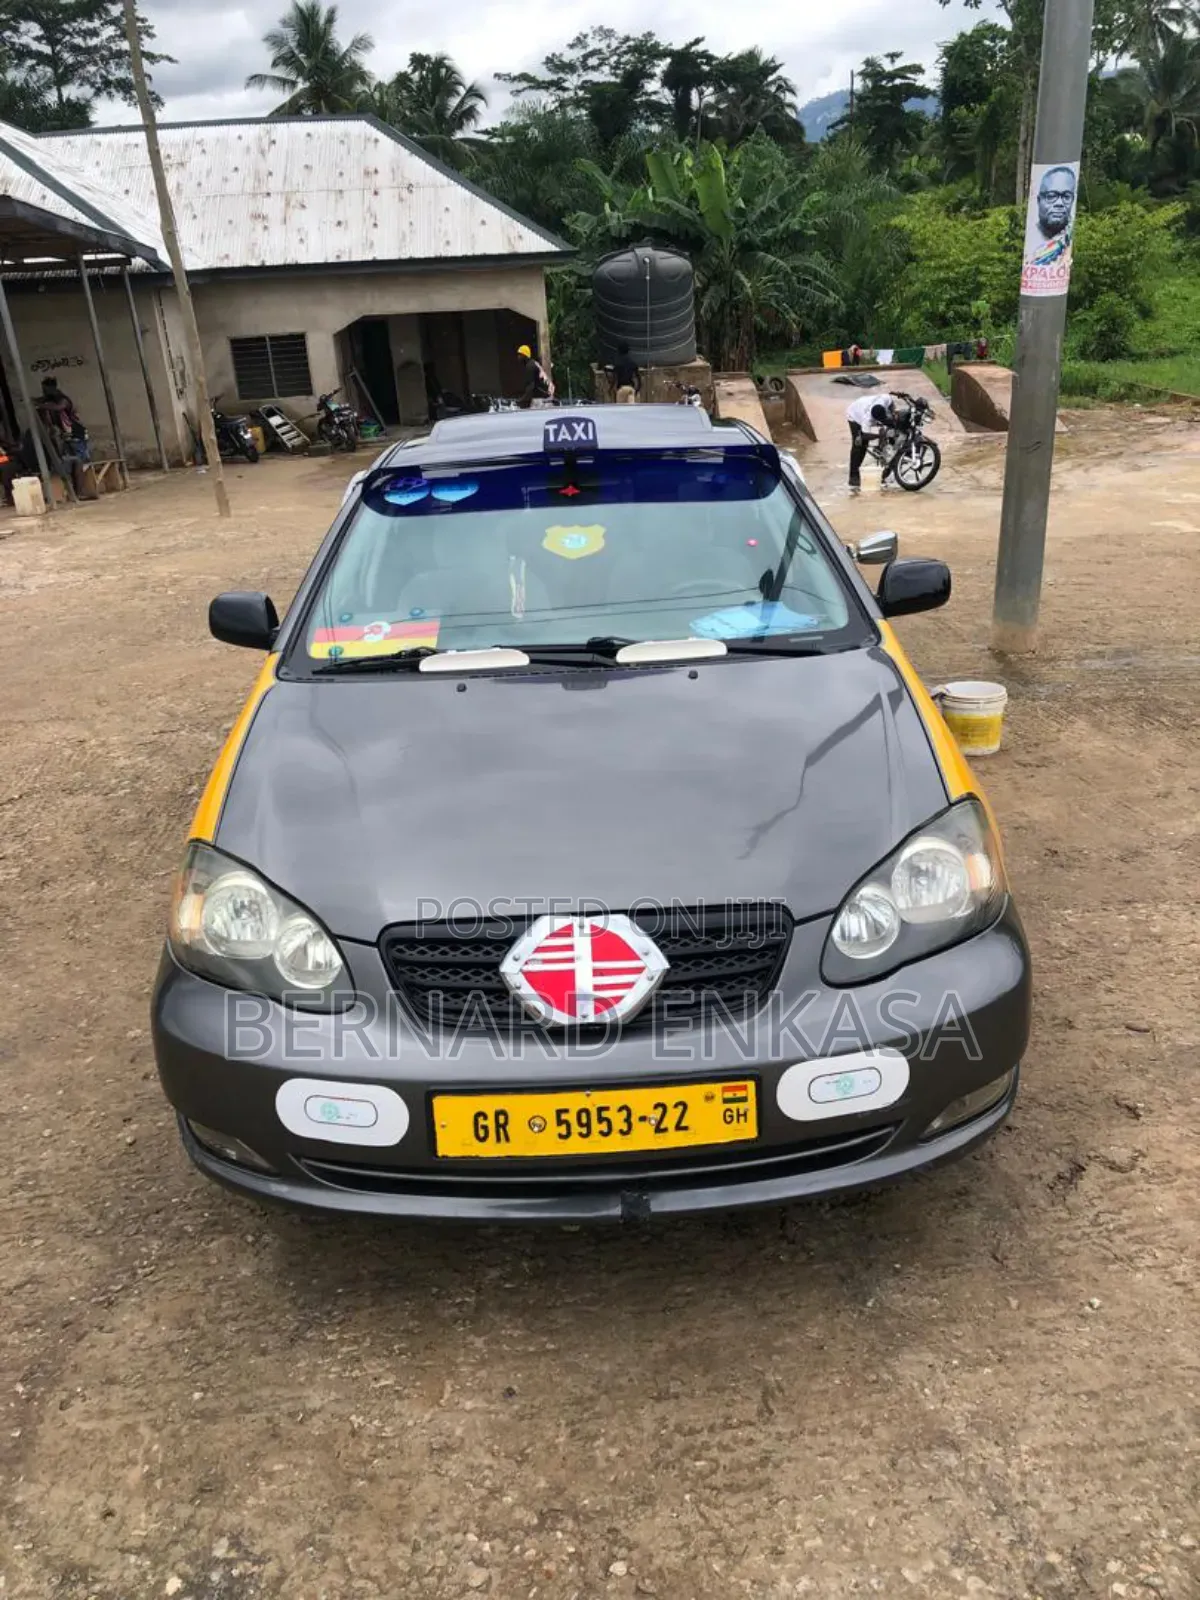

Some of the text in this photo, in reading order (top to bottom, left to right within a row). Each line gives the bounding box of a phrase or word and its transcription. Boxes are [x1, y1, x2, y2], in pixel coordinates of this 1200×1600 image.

[545, 422, 594, 442] TAXI
[473, 1100, 690, 1144] GR 5953-22
[723, 1107, 749, 1125] GH
